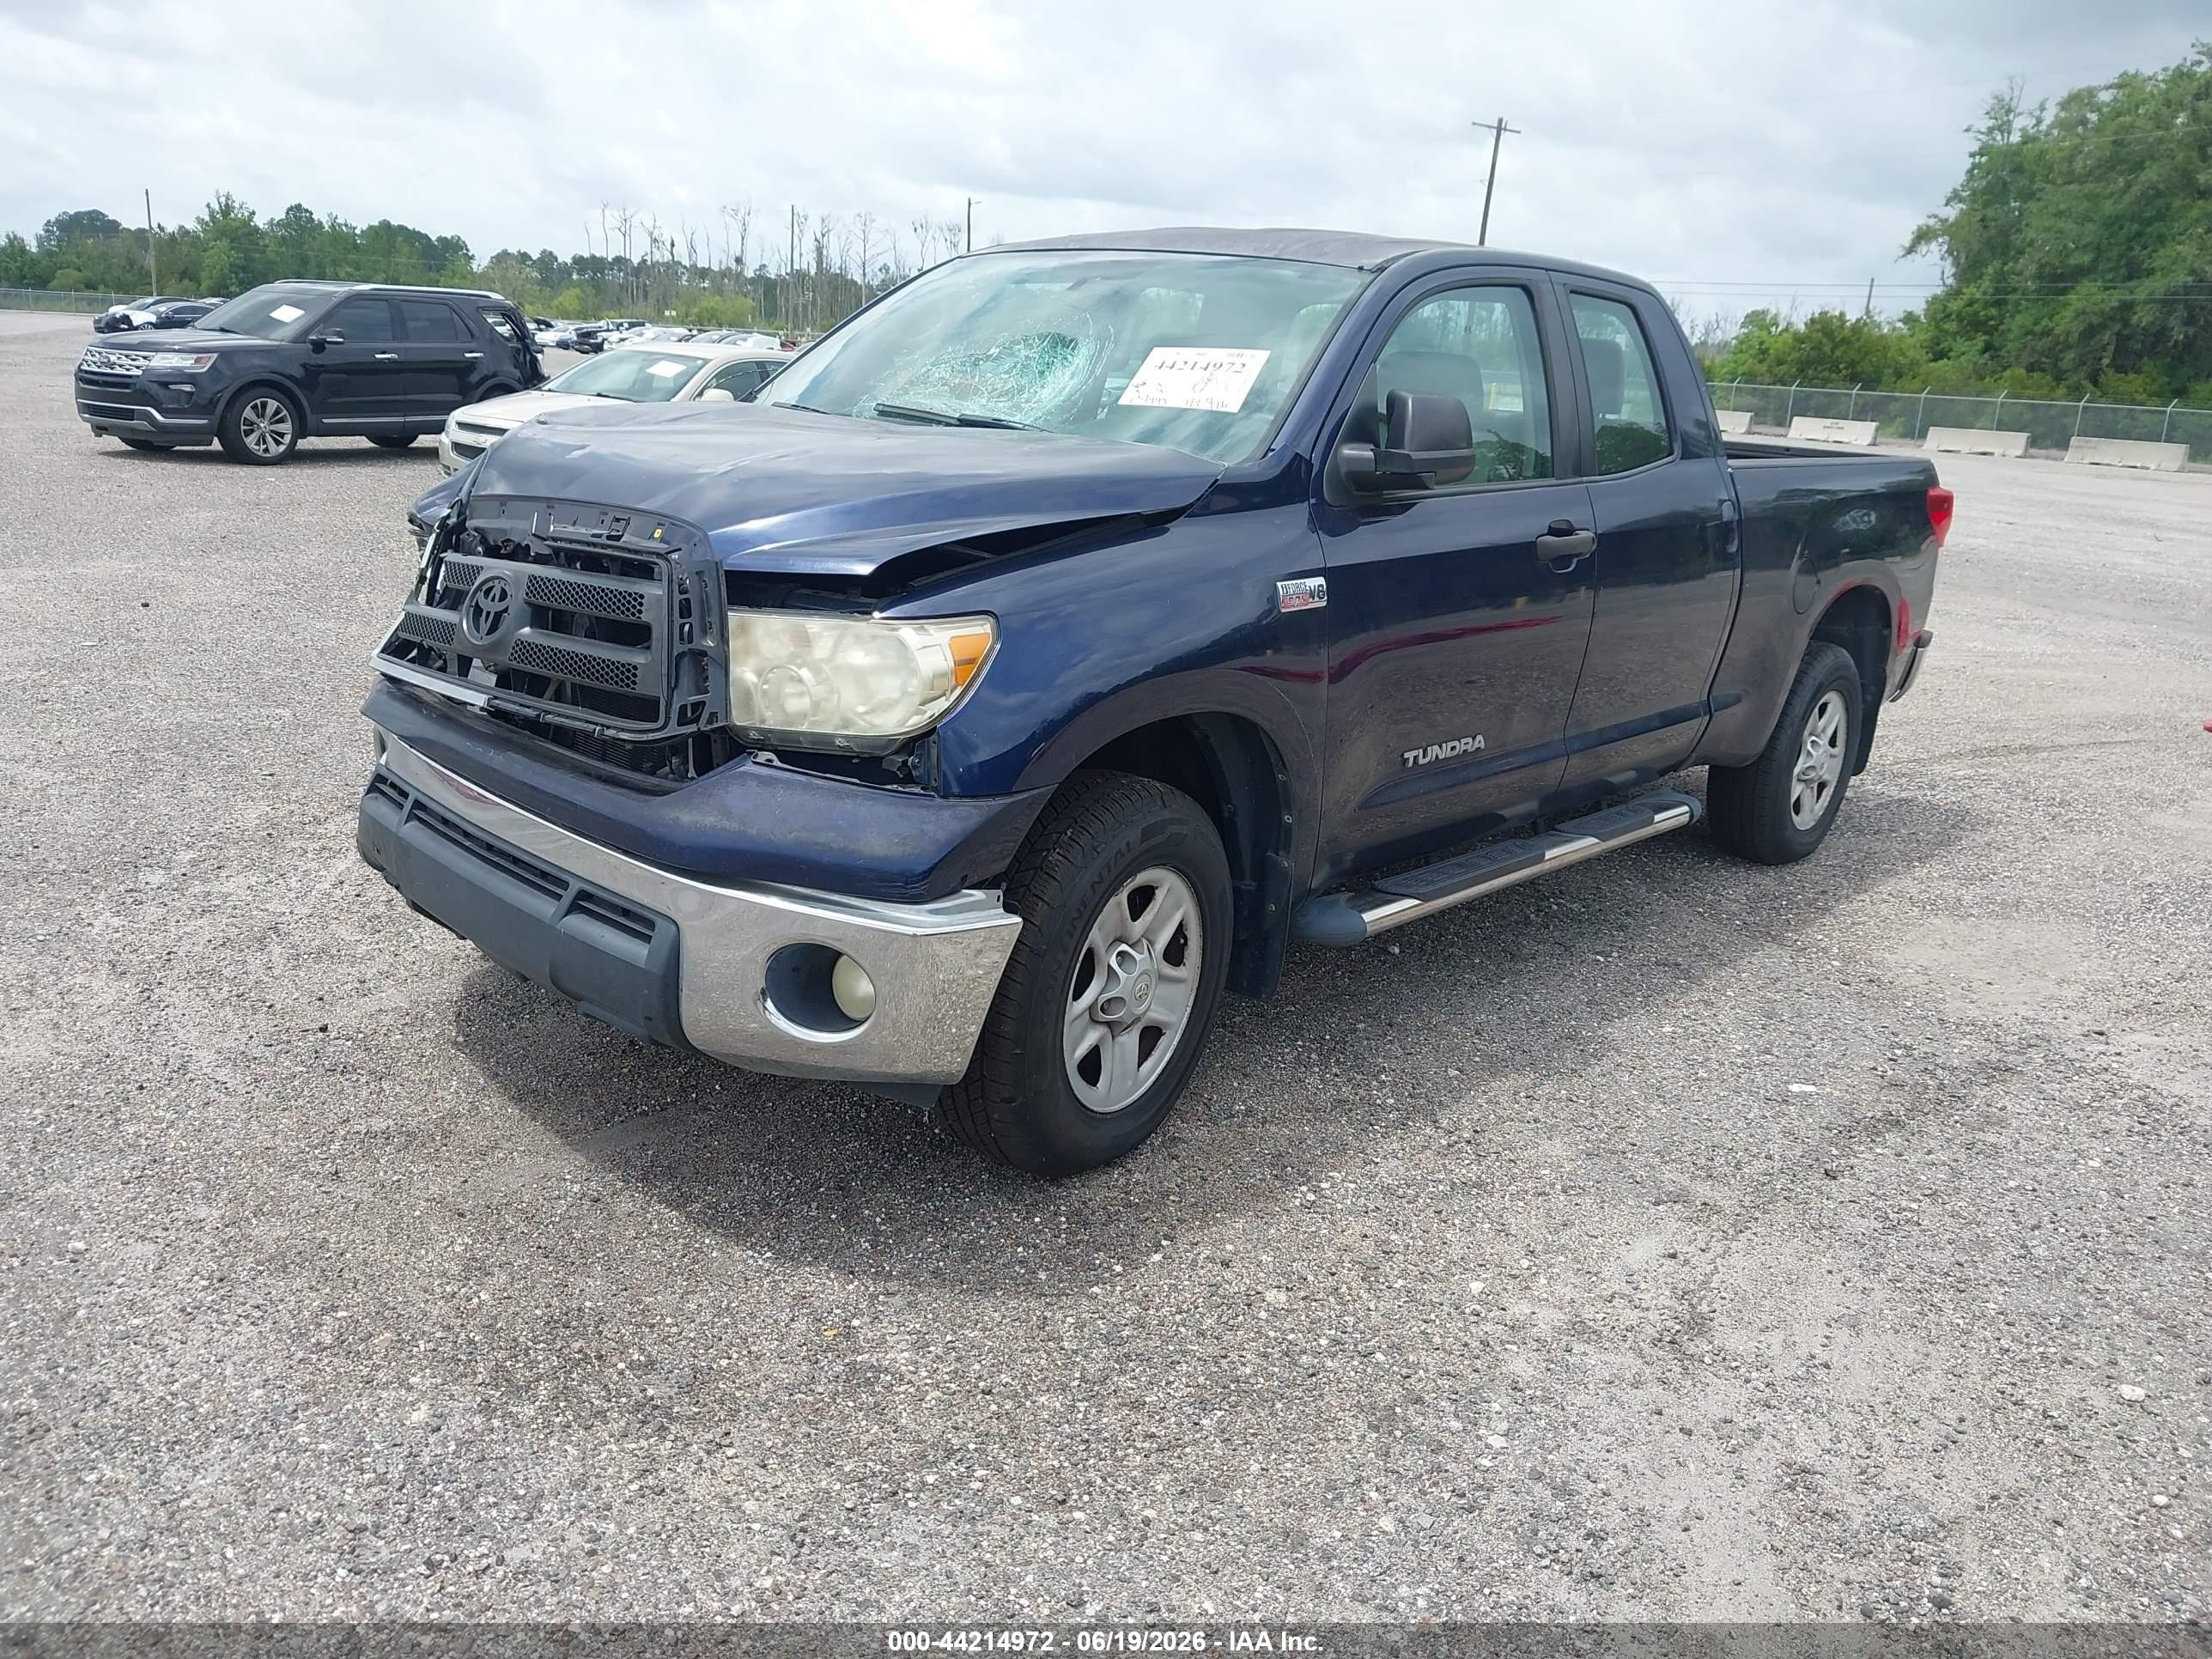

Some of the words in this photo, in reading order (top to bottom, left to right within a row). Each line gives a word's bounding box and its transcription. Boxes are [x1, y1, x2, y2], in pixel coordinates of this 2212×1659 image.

[1154, 359, 1247, 374] 44214972
[1309, 584, 1326, 601] V8
[1403, 734, 1486, 768] TUNDRA
[1040, 834, 1133, 1022] ONINENTAL
